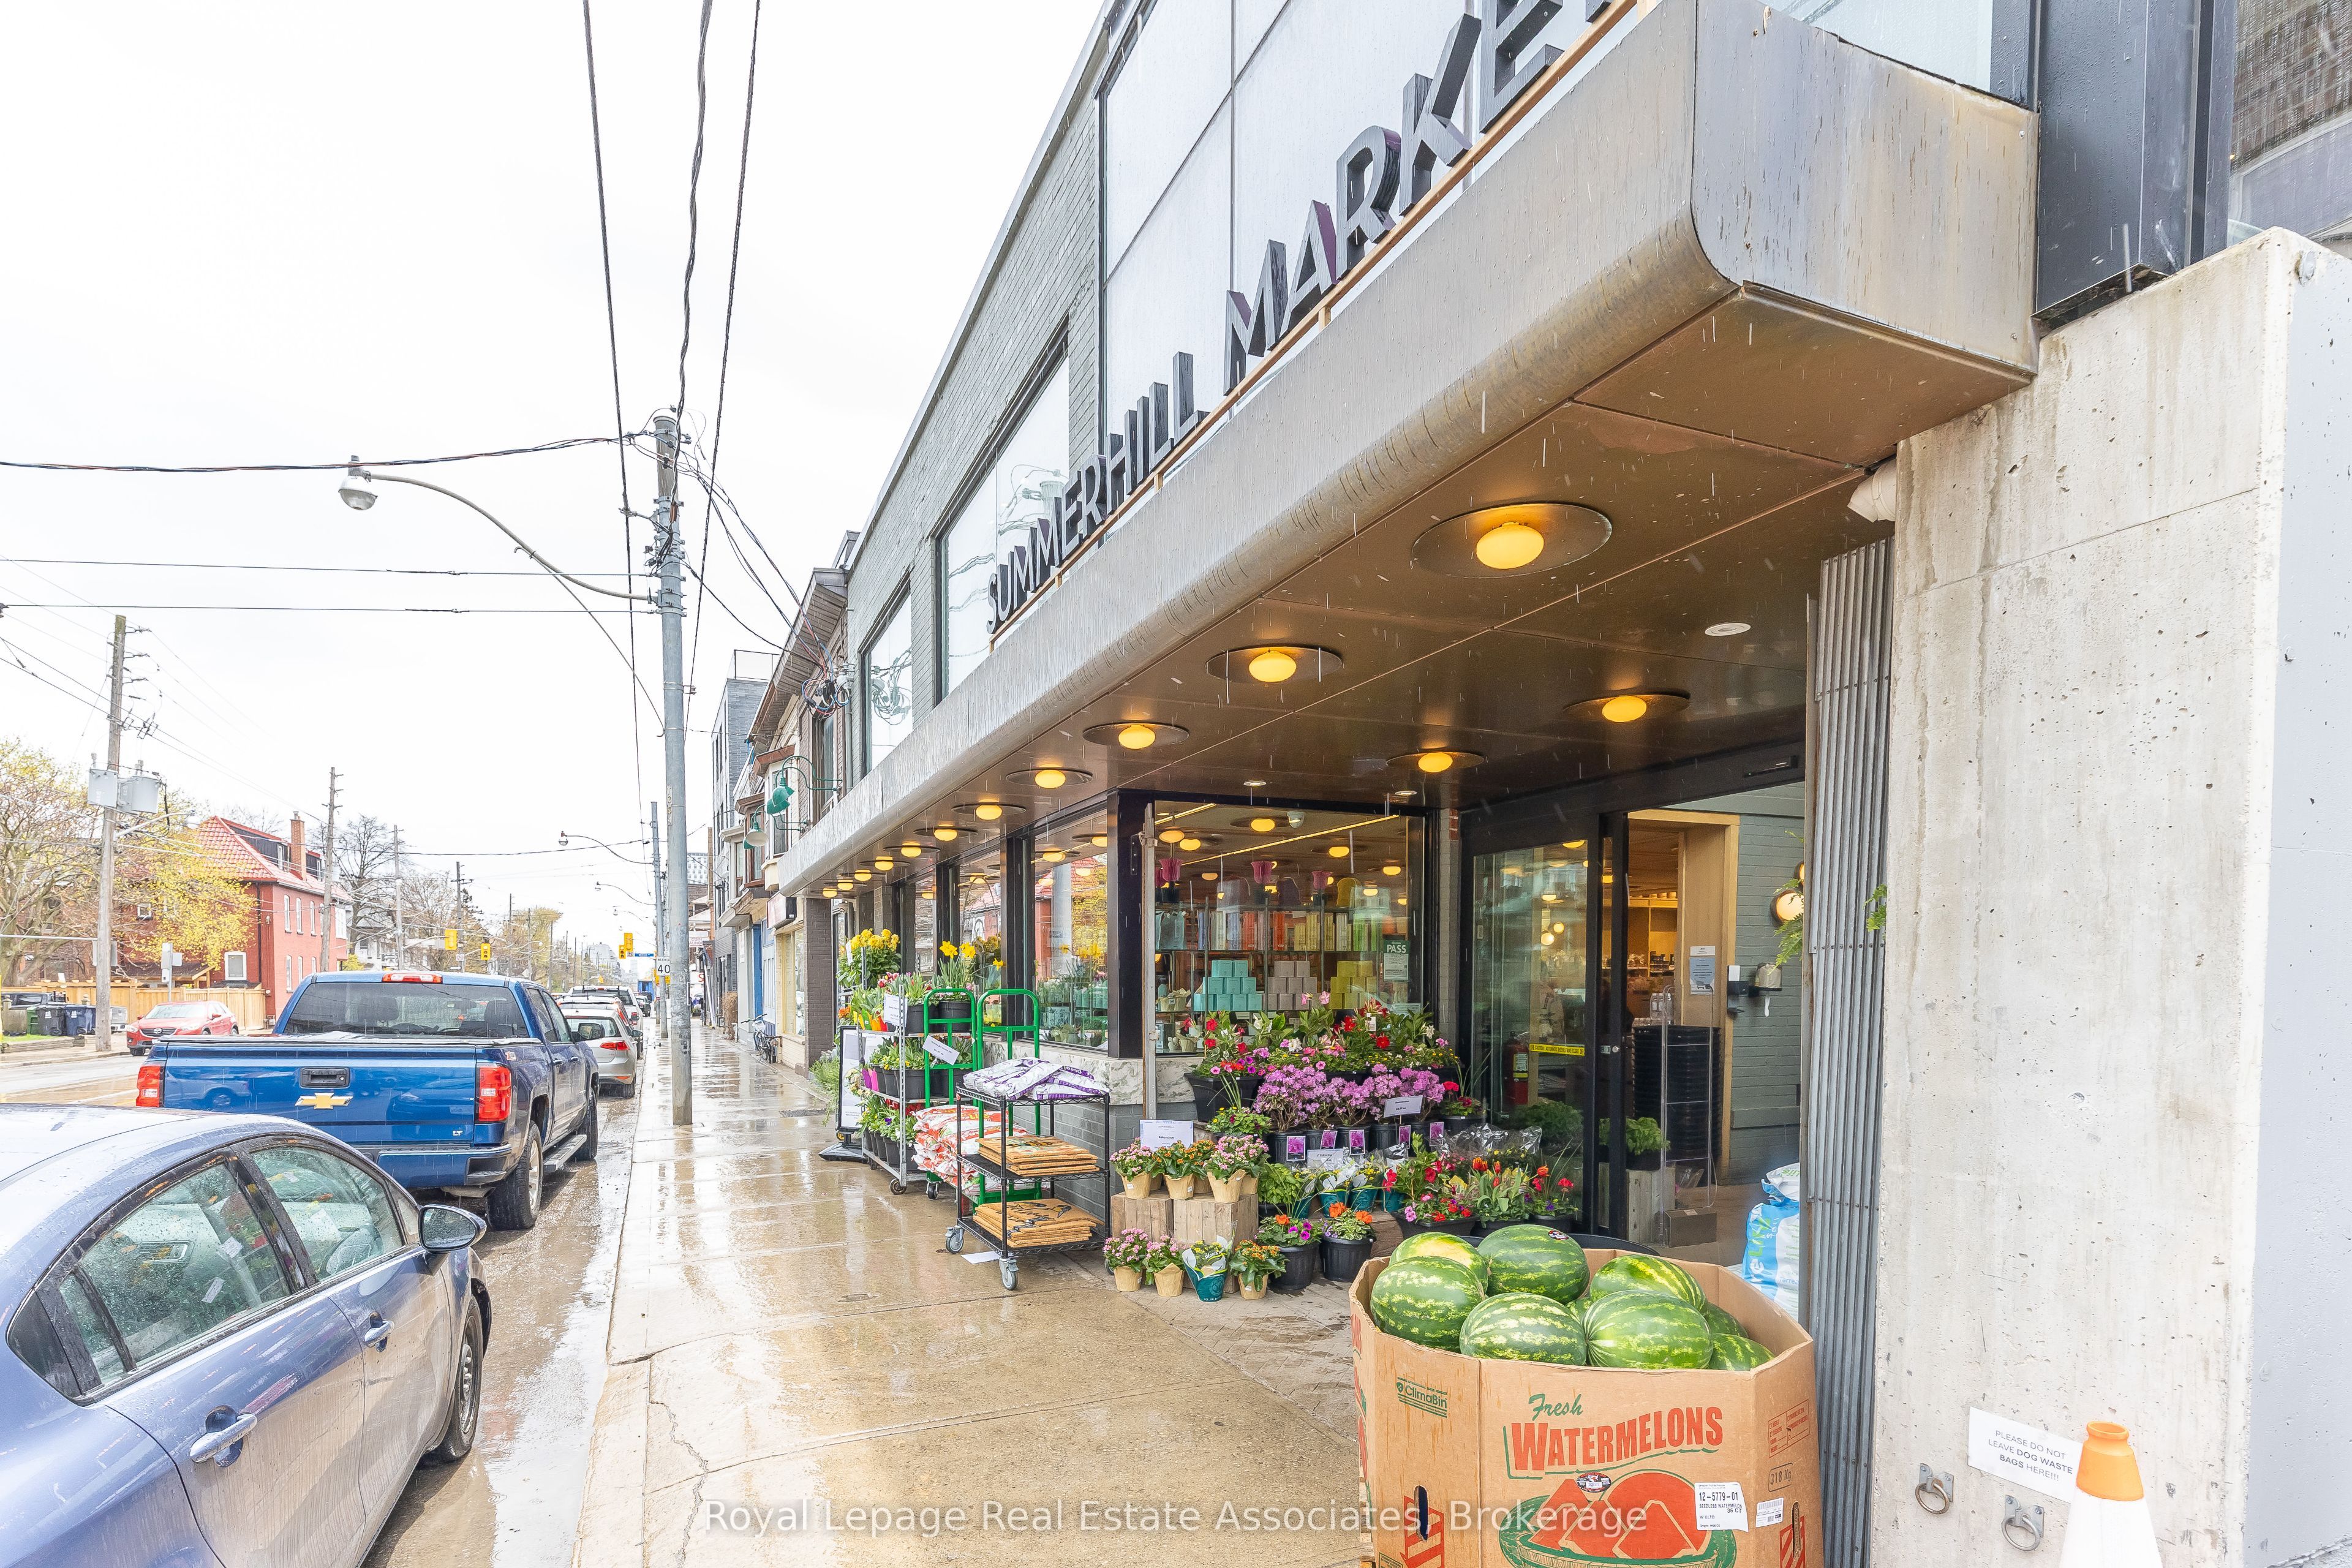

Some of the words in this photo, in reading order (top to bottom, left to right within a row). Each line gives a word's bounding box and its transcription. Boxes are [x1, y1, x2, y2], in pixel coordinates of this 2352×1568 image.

[987, 352, 1211, 635] SUMMERHILL
[1224, 0, 1616, 397] MARKE
[1387, 944, 1407, 953] PASS
[658, 965, 670, 973] 40
[1405, 1385, 1447, 1409] ClimaBin
[1528, 1393, 1583, 1421] Fresh
[1512, 1406, 1723, 1471] WATERMELONS
[1996, 1430, 2028, 1447] PLEASE
[2030, 1442, 2044, 1452] DO
[2046, 1447, 2066, 1460] NOT
[1988, 1439, 2015, 1453] LEAVE
[2017, 1449, 2038, 1461] DOG
[2040, 1457, 2073, 1474] WASTE
[2000, 1454, 2024, 1468] BAGS
[2026, 1464, 2059, 1481] HERE!!!
[1770, 1471, 1782, 1485] 318
